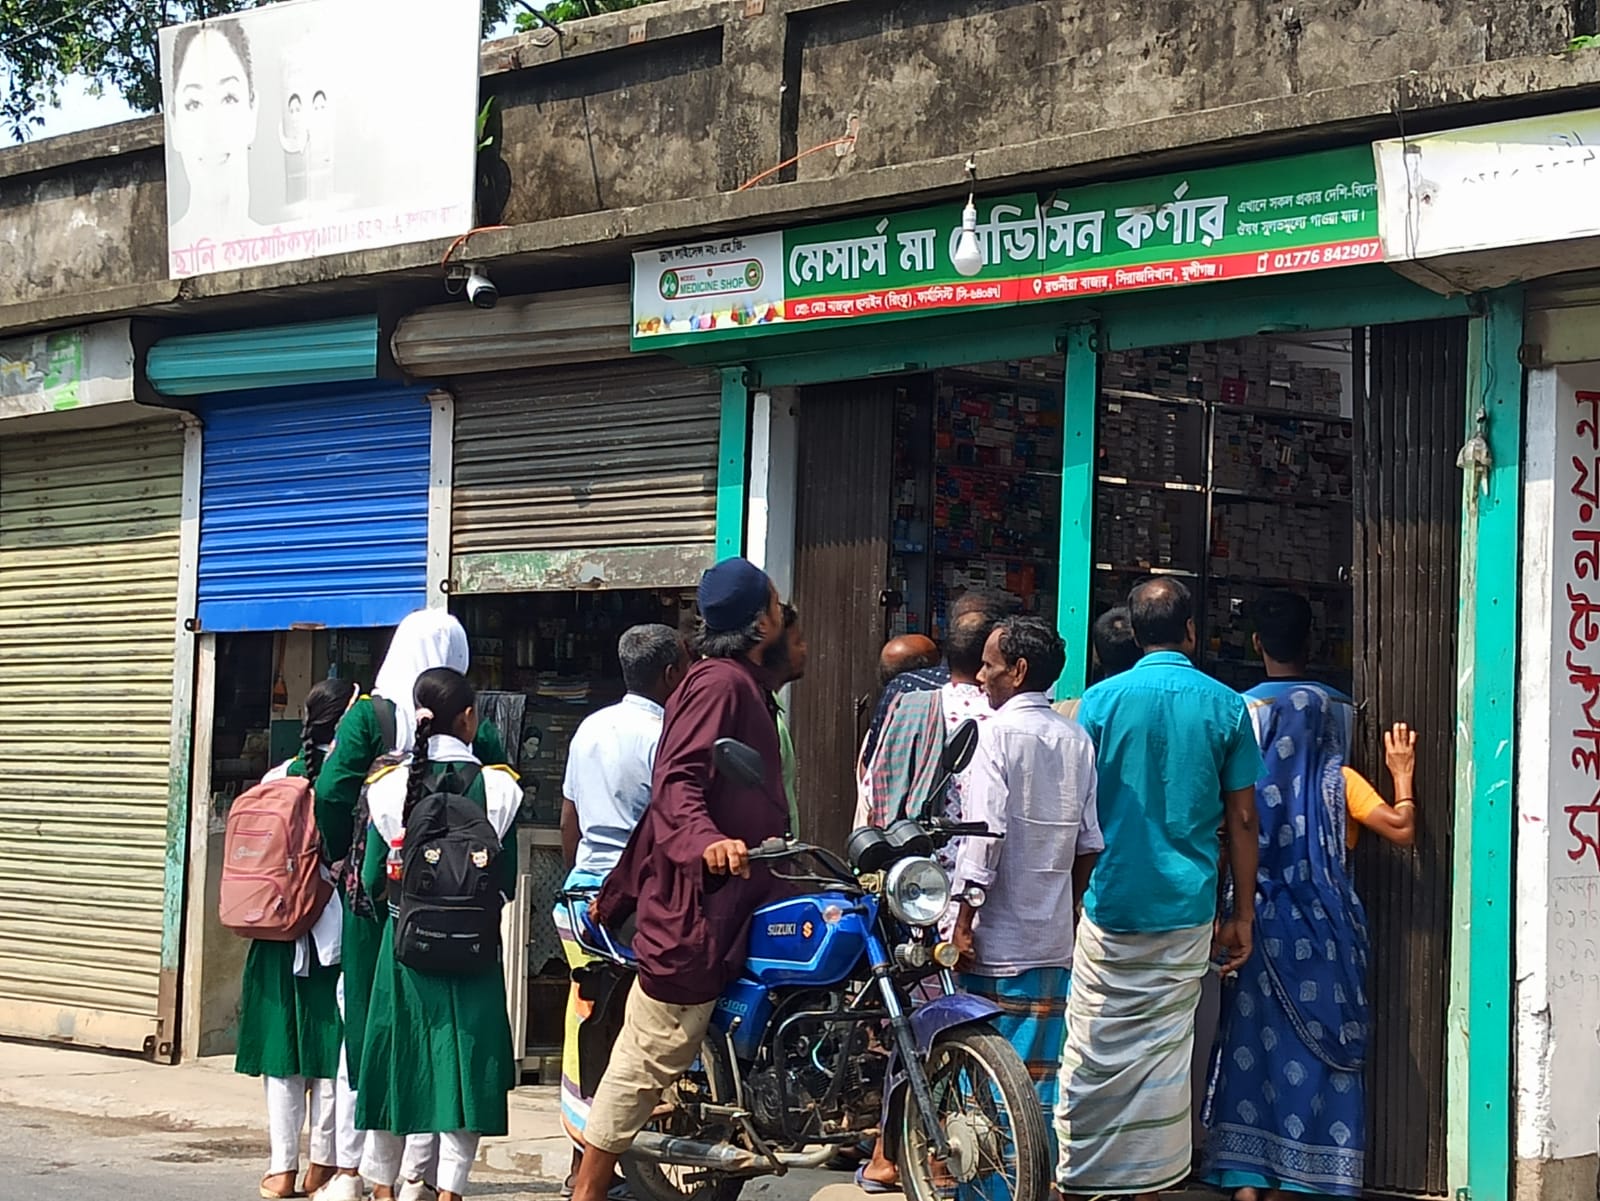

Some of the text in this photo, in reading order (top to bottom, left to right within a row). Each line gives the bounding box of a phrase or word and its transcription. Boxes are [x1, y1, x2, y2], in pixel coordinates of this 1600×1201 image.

[1237, 198, 1268, 213] এখানে
[1269, 194, 1294, 209] সকল
[789, 217, 889, 286] মেসার্স
[897, 229, 936, 271] মা
[1115, 180, 1229, 248] কর্ণার
[1274, 242, 1379, 269] 01776 842907
[680, 277, 745, 294] MEDICINE SHOP
[767, 923, 797, 936] SUZUKI
